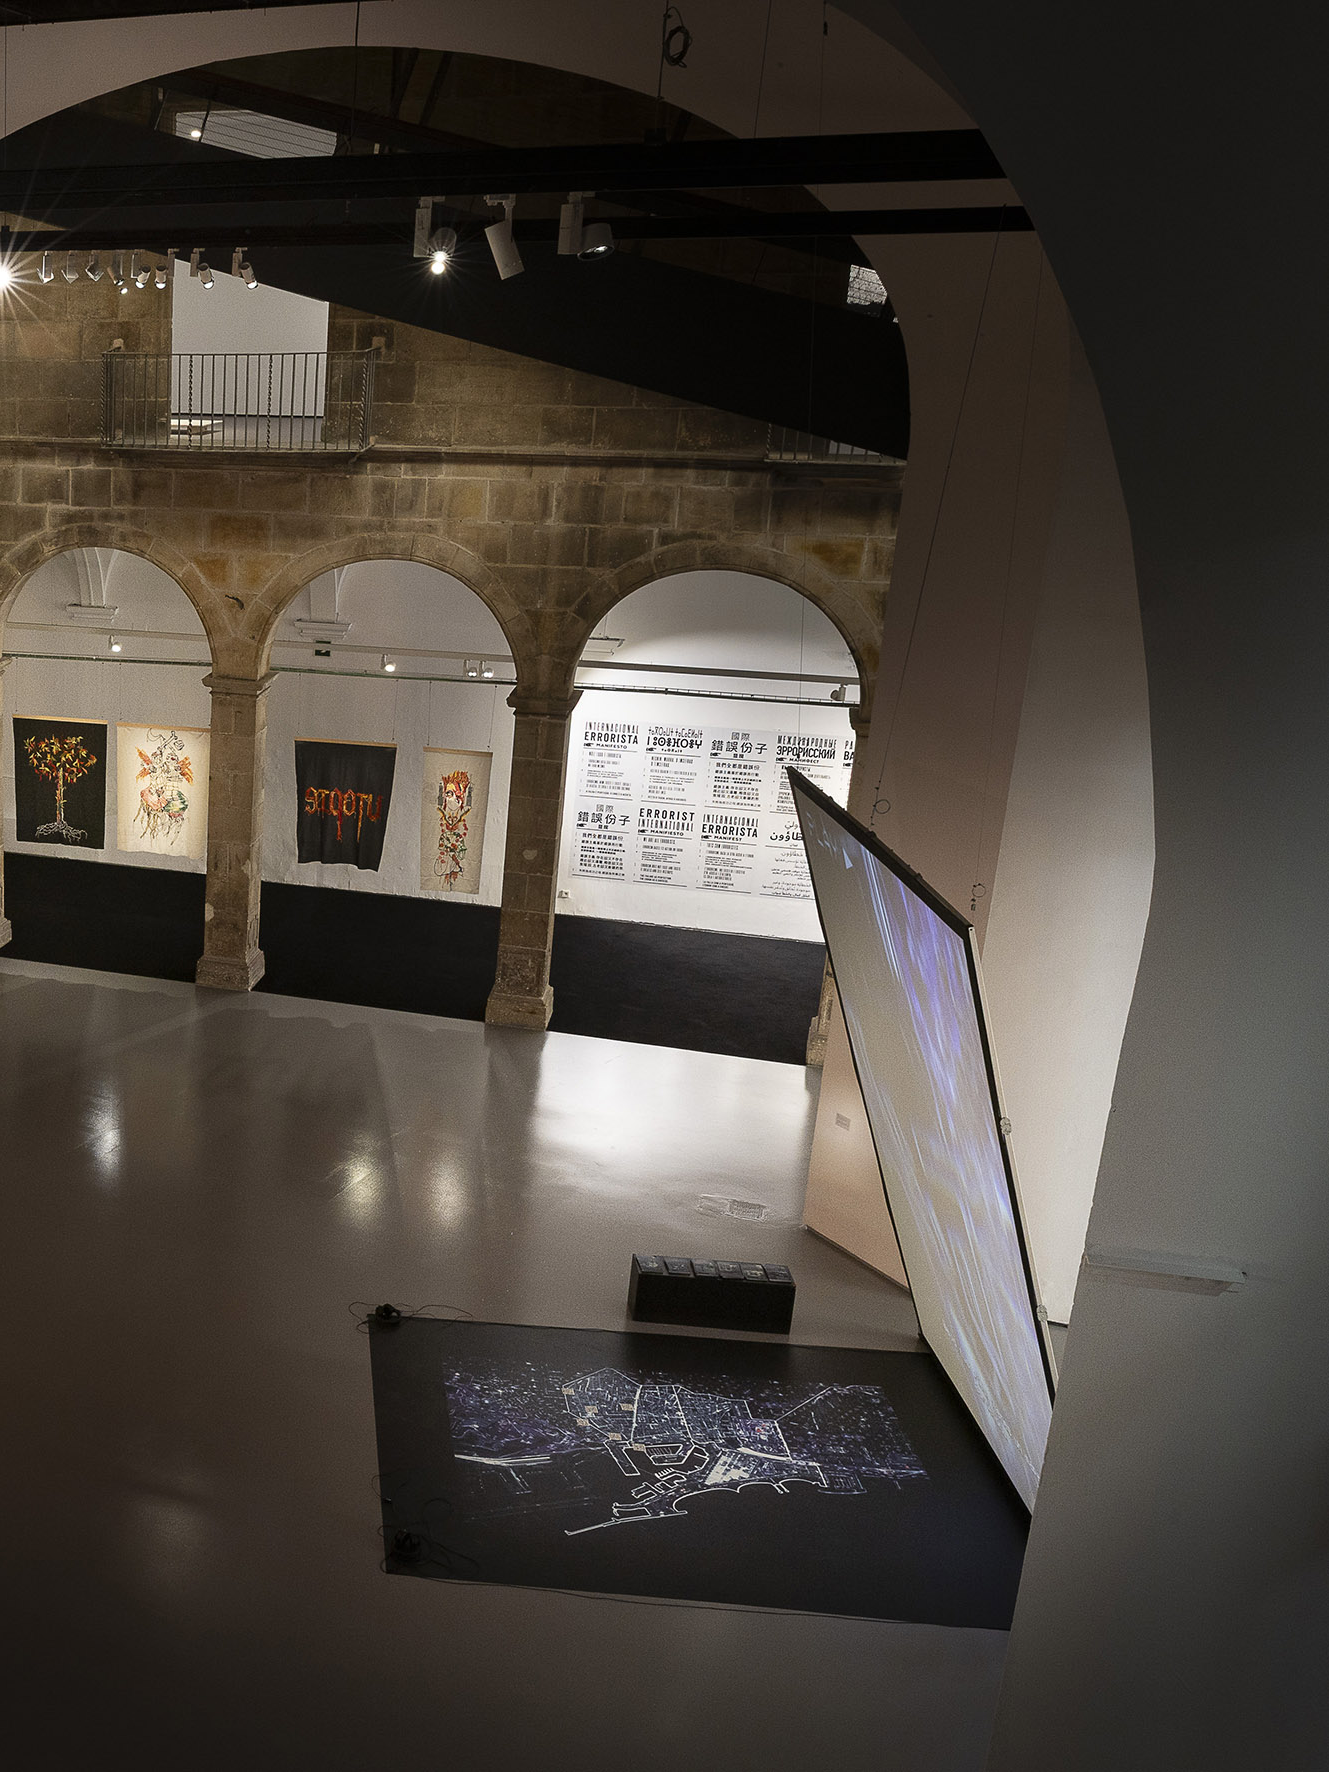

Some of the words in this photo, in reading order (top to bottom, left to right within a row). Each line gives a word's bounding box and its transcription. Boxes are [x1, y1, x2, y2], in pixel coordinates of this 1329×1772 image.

[584, 721, 639, 735] INTERNACIONAL
[583, 731, 639, 745] ERRORISTA
[711, 739, 768, 755] 錯誤份子
[577, 810, 631, 826] 錯誤份子
[639, 807, 696, 822] ERRORIST
[702, 813, 759, 828] INTERNACIONAL
[637, 818, 694, 832] INTERNATIONAL
[701, 823, 758, 838] ERRORISTA
